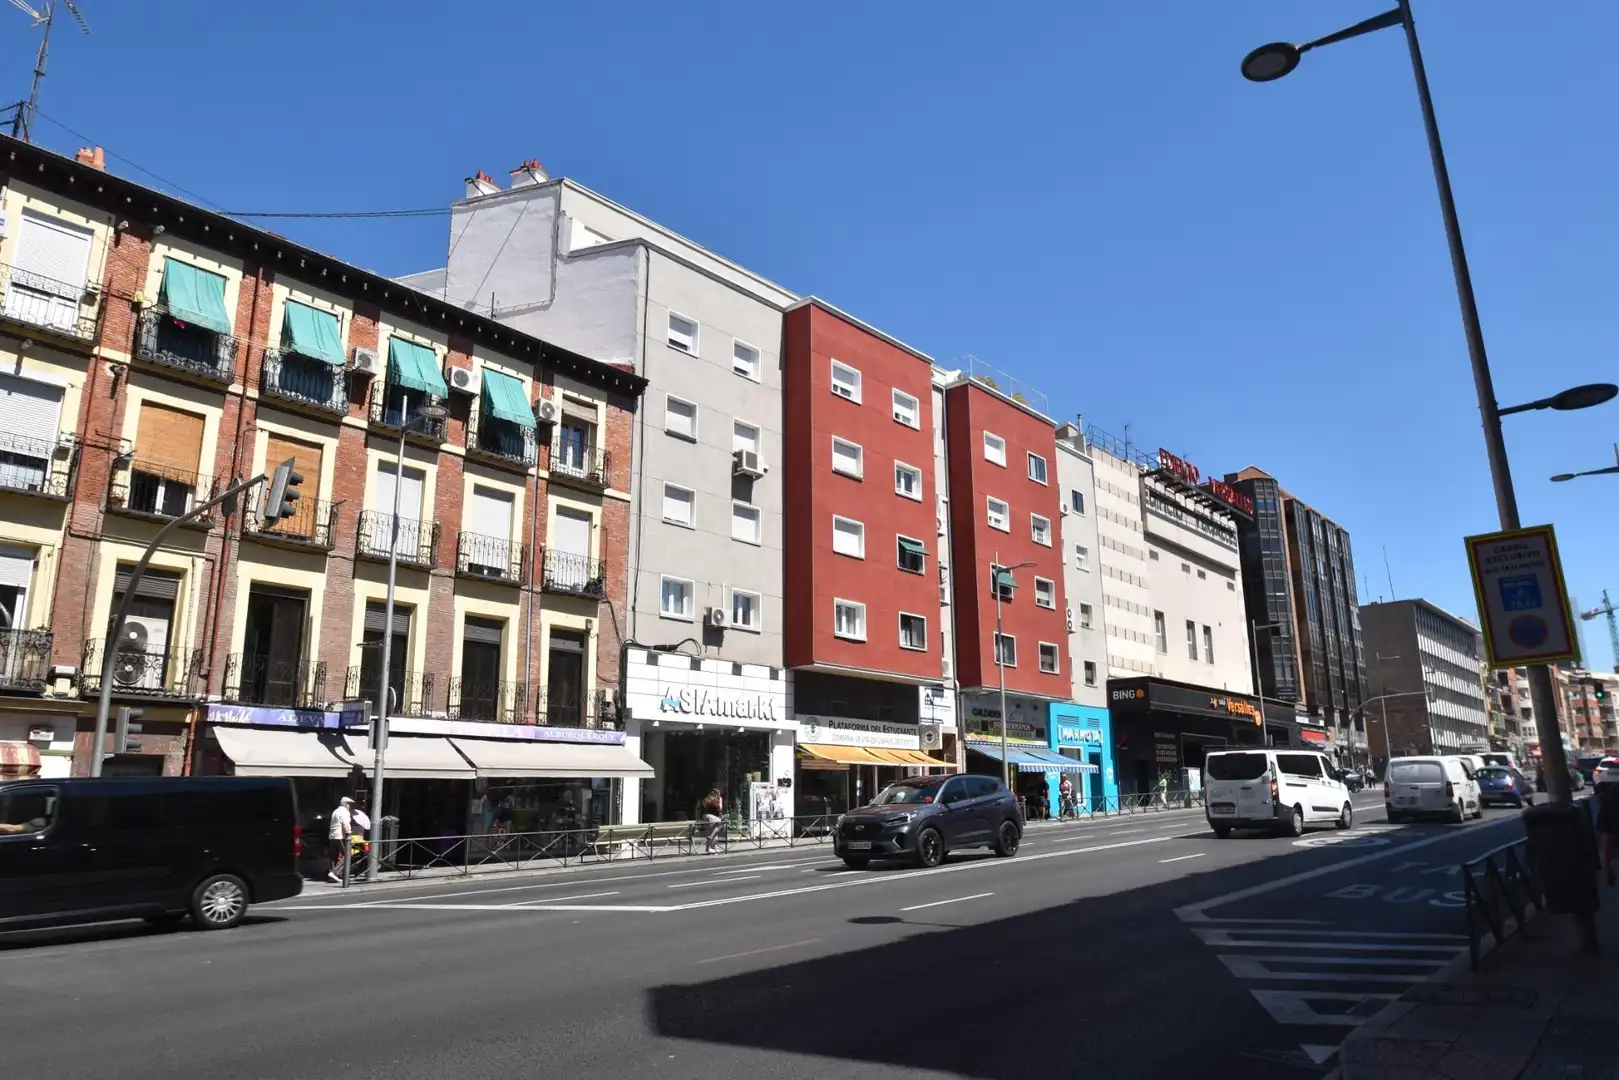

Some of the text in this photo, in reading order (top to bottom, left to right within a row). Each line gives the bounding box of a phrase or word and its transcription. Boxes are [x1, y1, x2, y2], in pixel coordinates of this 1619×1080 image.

[828, 719, 870, 733] PLATAFORMA
[870, 725, 882, 733] DEL
[882, 724, 917, 736] ESTUDIANTE
[1322, 883, 1477, 908] BUS
